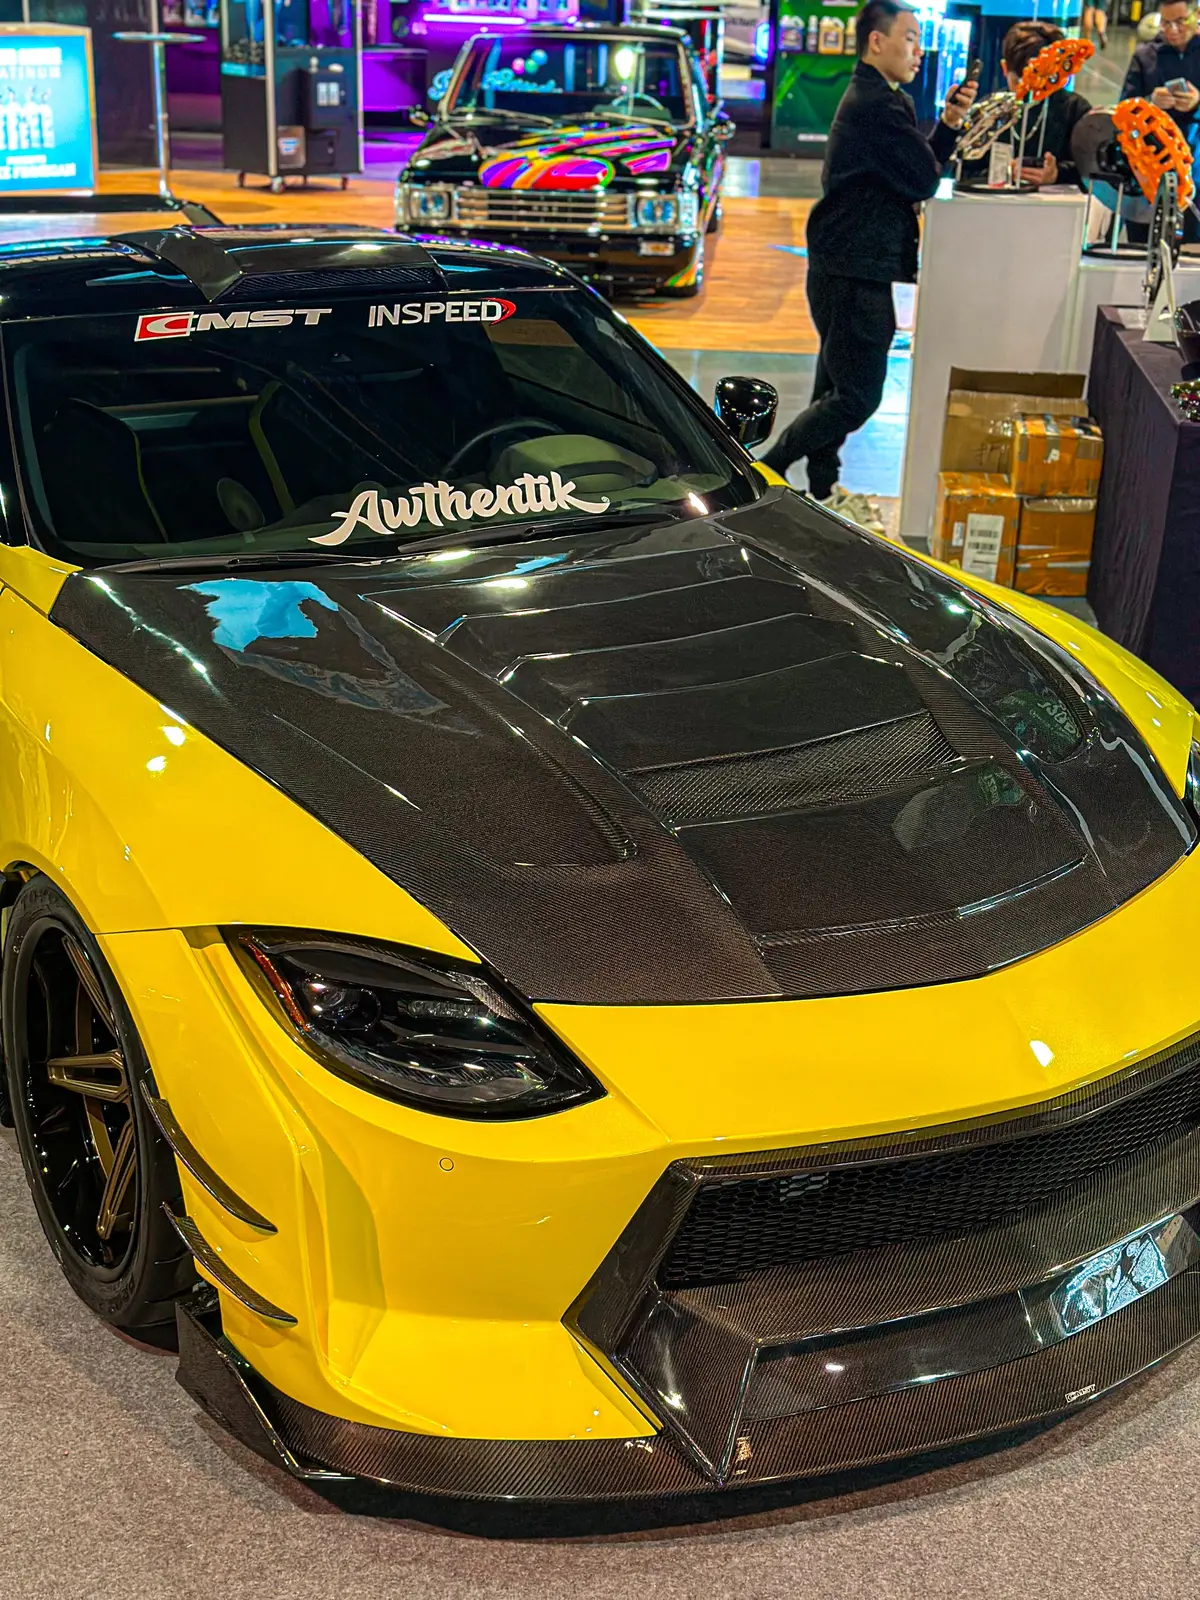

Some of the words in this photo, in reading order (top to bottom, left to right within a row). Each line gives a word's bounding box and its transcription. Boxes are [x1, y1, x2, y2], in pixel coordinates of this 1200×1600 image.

[134, 308, 332, 342] CMST
[368, 301, 503, 327] INSPEED
[307, 471, 610, 546] Awthentik
